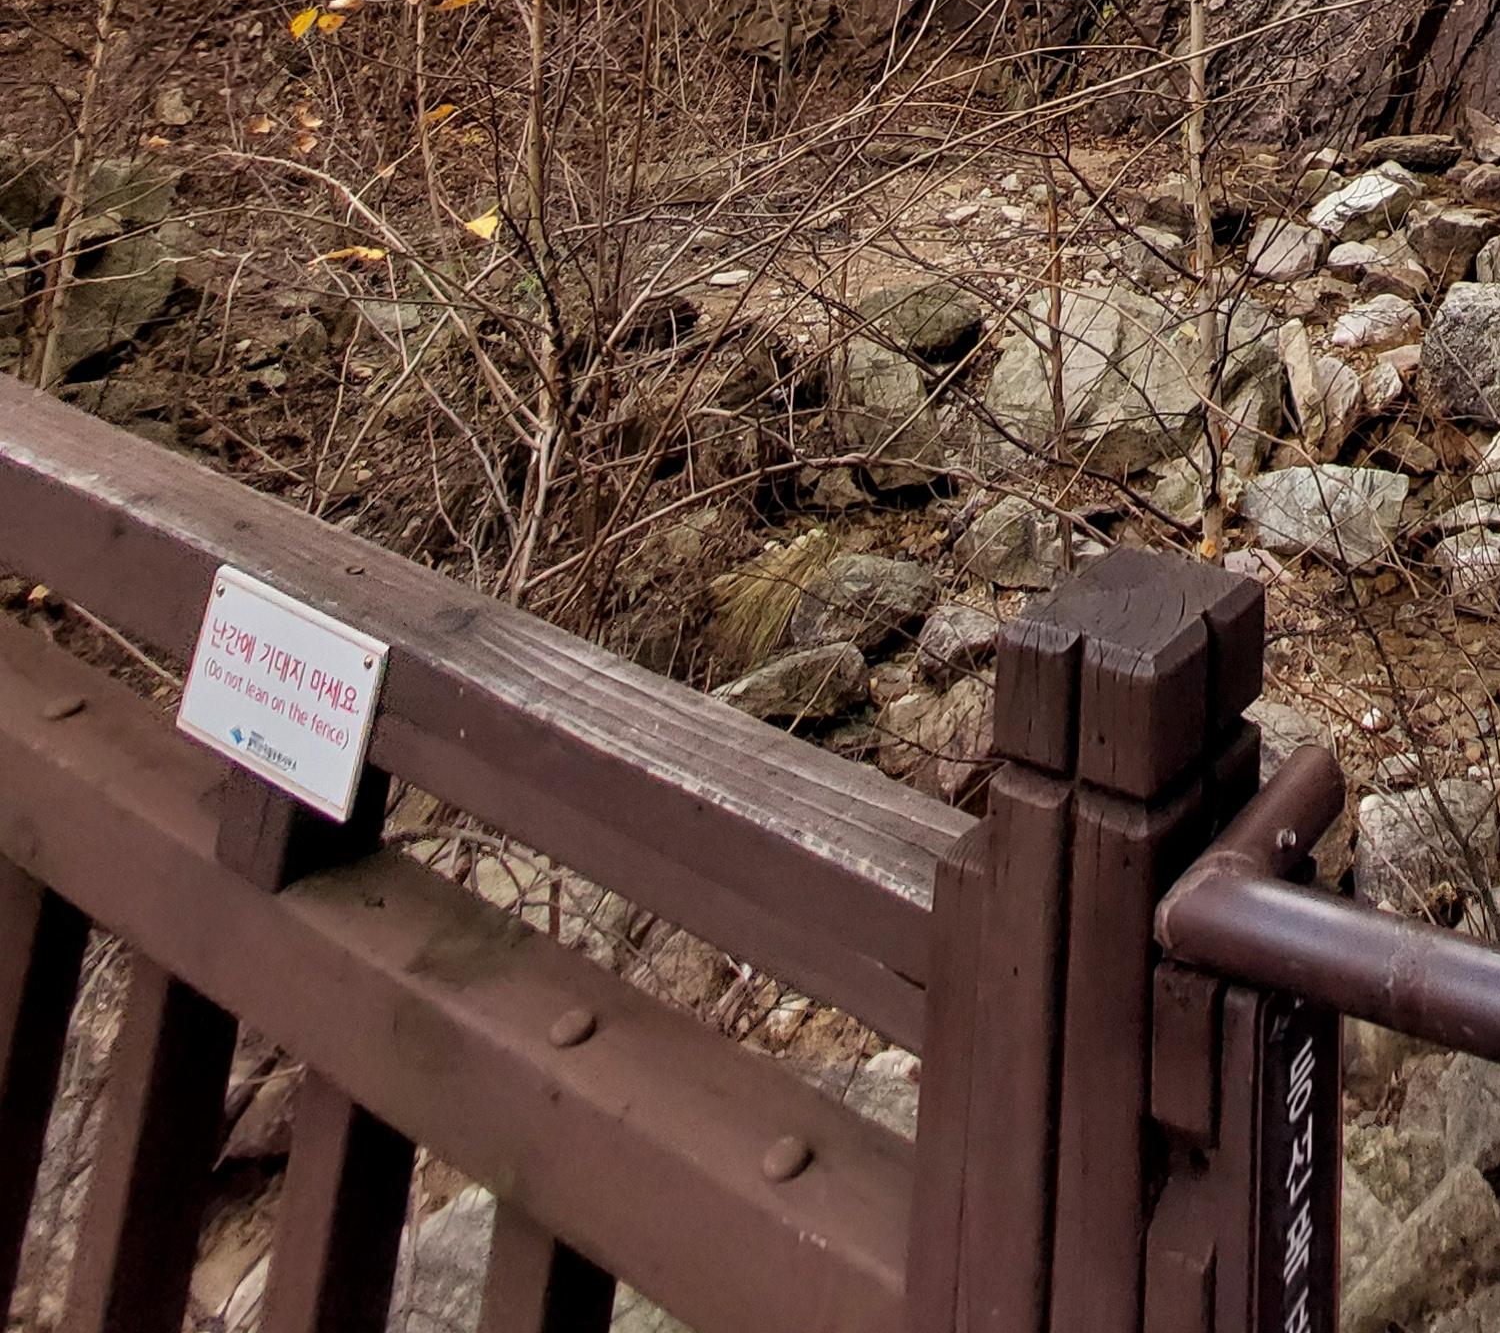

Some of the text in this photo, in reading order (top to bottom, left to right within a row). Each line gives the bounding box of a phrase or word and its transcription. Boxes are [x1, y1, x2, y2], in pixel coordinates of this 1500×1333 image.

[211, 618, 257, 665] 난간에
[259, 643, 307, 691] 기대지
[224, 671, 243, 692] not
[245, 679, 269, 706] lean
[271, 696, 285, 715] on
[288, 702, 308, 726] the
[310, 713, 350, 751] fence)
